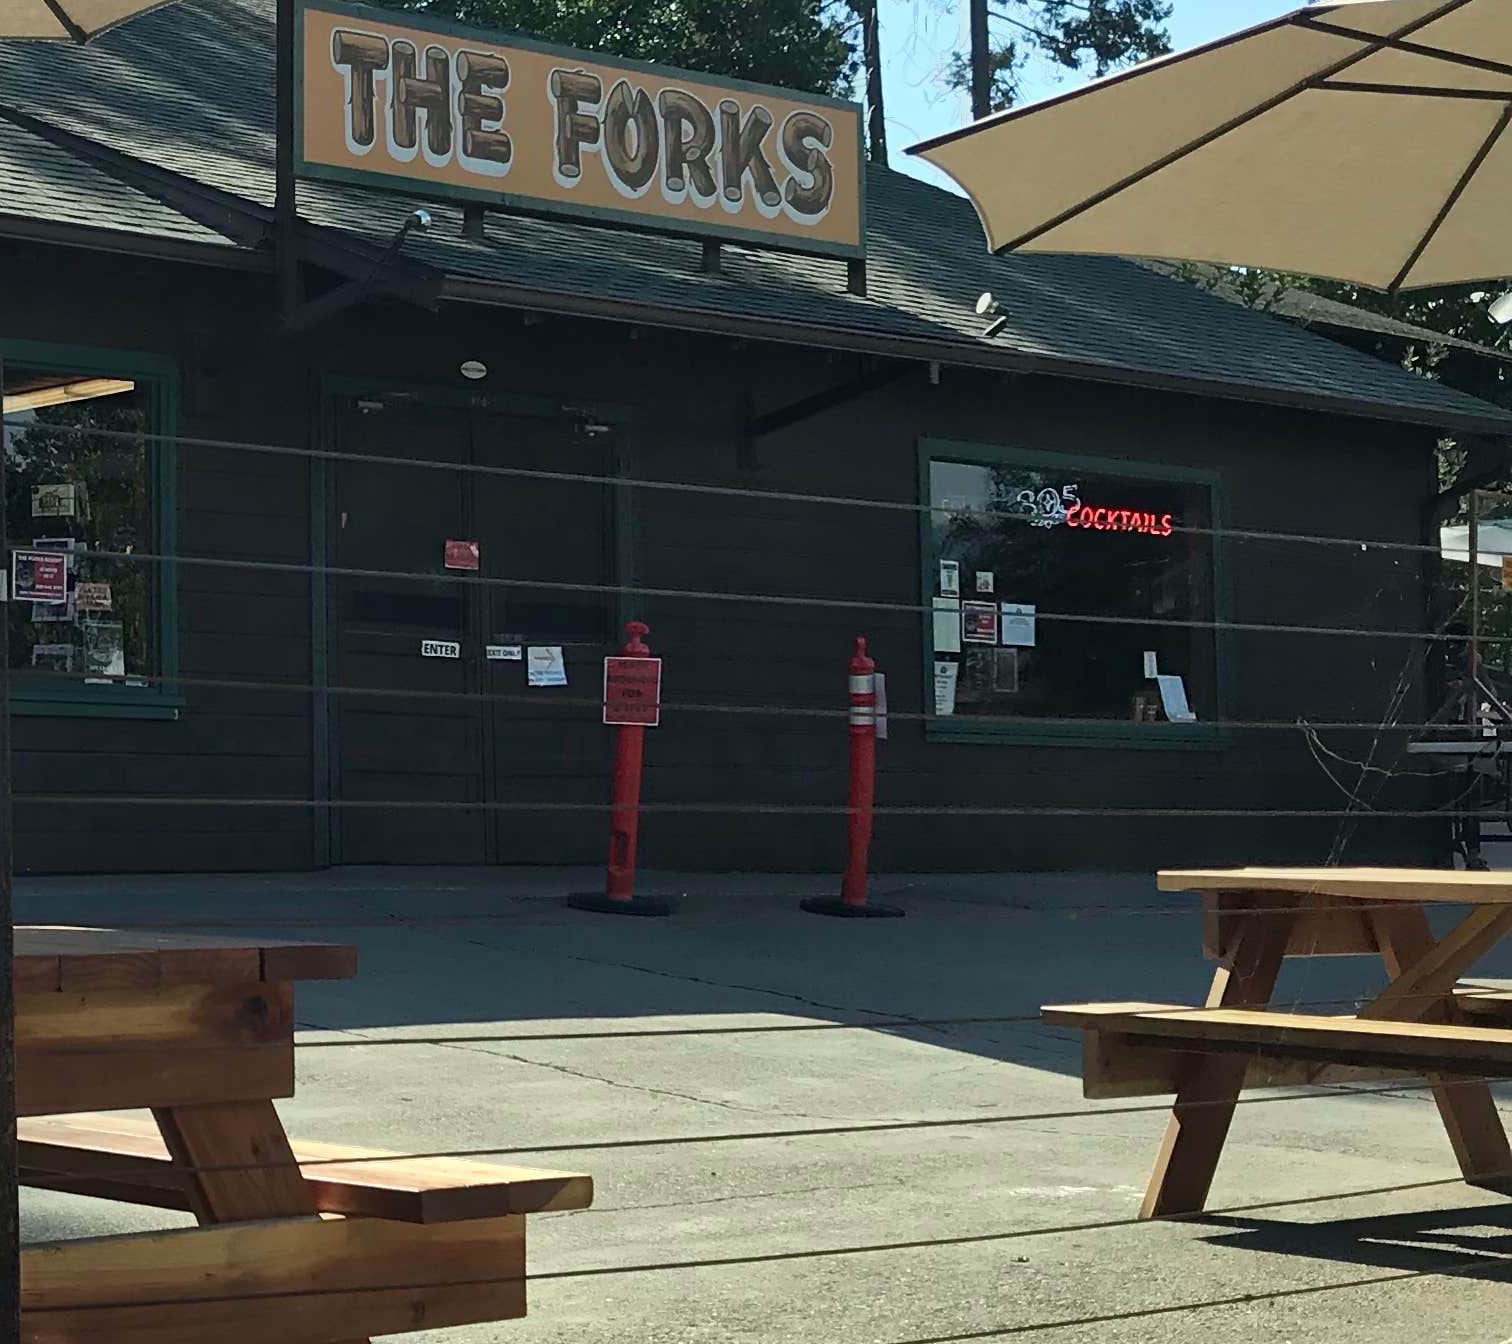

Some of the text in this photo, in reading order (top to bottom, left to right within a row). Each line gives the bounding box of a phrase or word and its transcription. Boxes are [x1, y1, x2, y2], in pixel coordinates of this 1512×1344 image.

[330, 27, 835, 226] THE FORKS
[1066, 507, 1173, 537] COCKTAILS
[424, 643, 457, 656] ENTER
